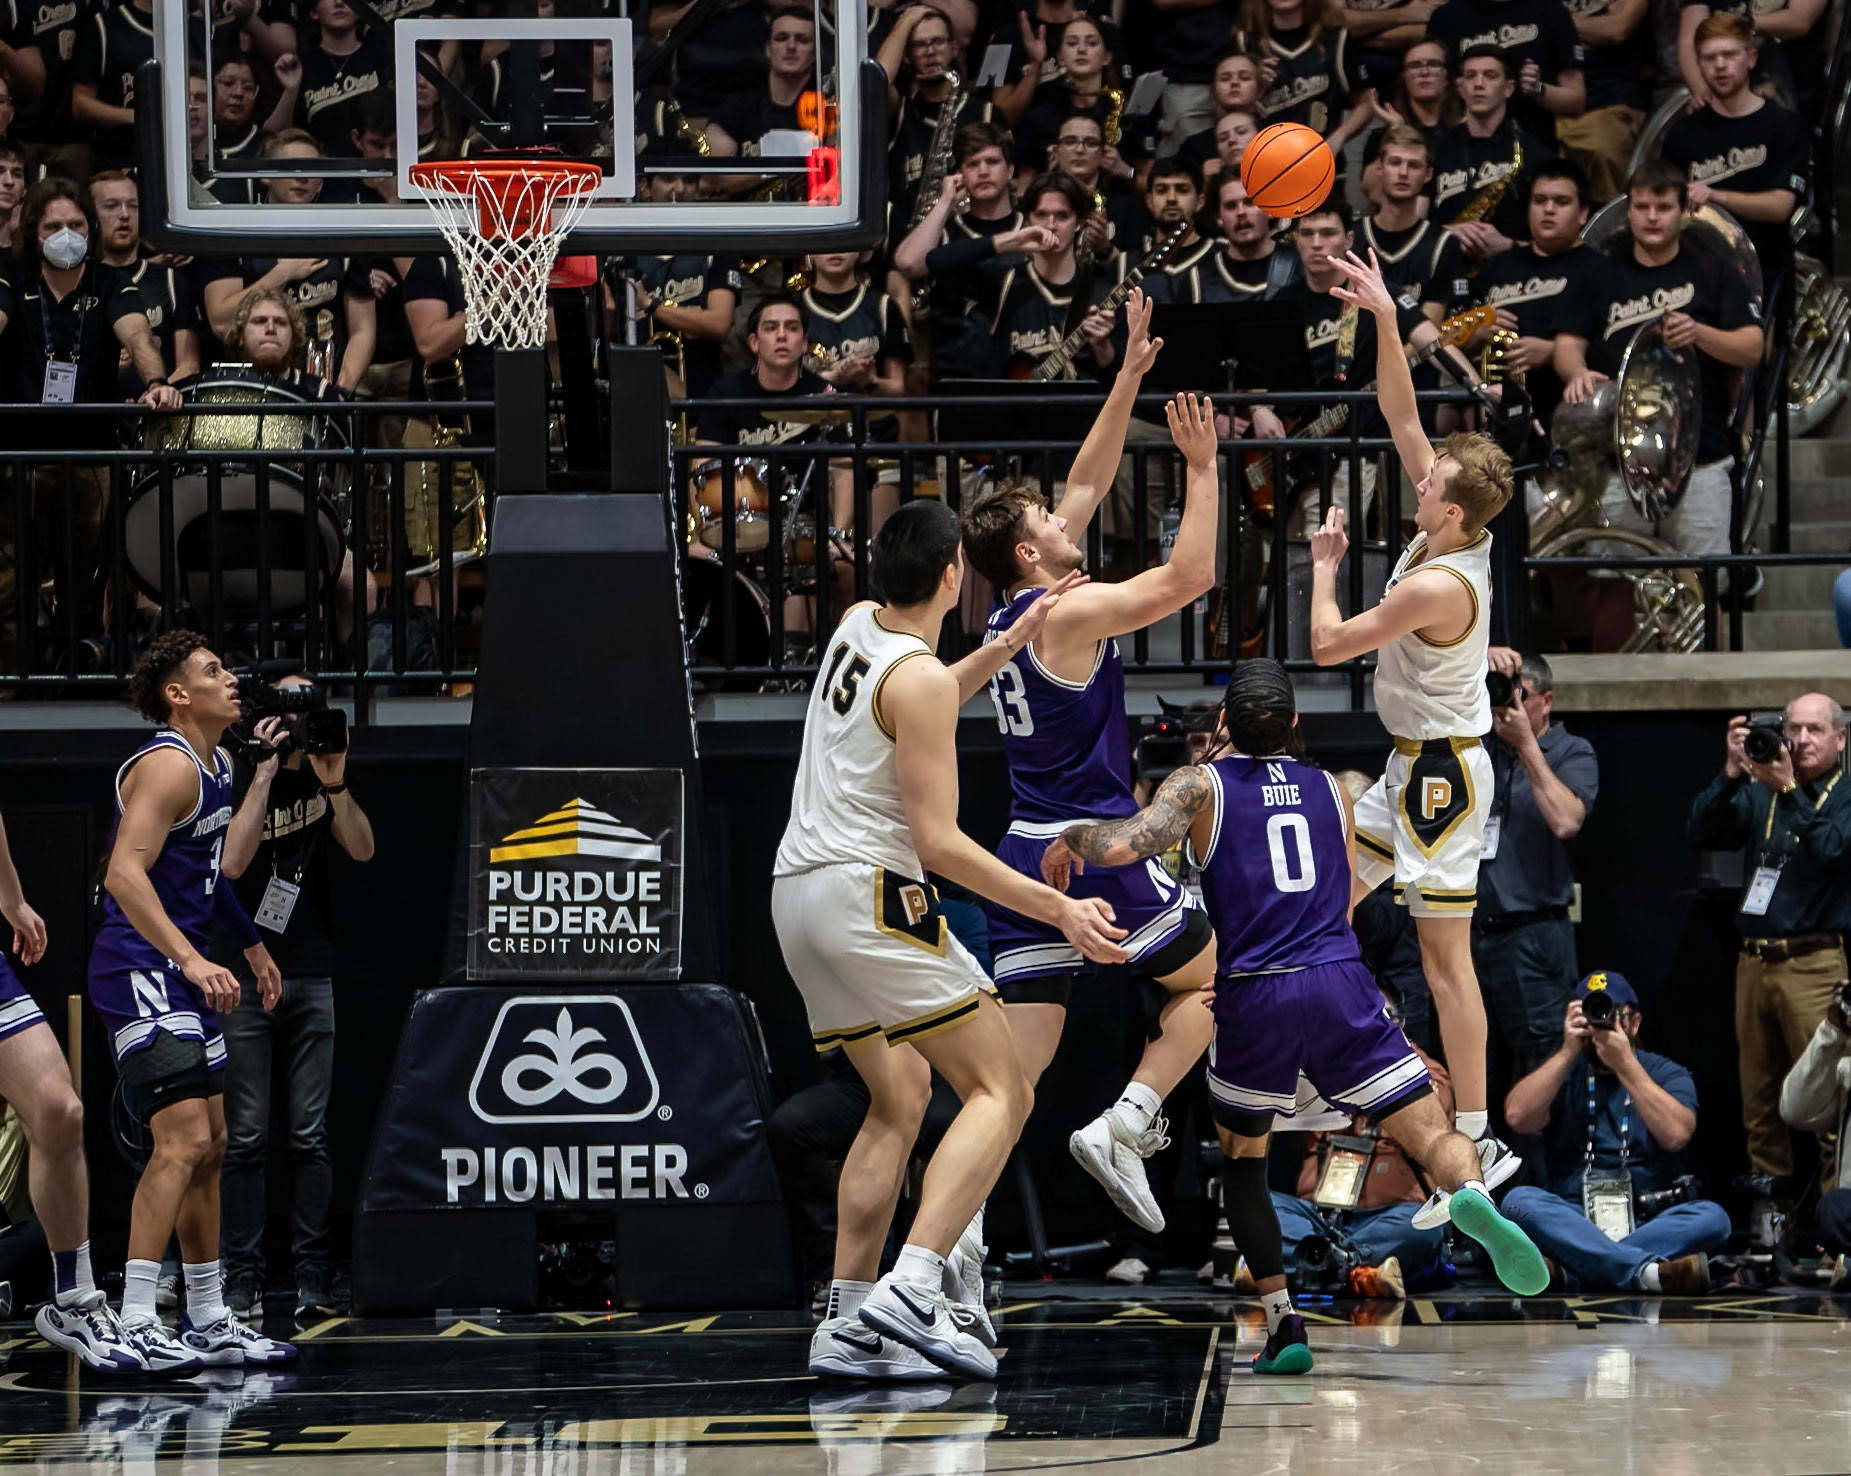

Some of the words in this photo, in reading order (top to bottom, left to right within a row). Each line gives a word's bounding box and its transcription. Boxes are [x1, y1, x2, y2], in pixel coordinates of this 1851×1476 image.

[1608, 294, 1652, 325] Paint
[1651, 281, 1695, 310] Crew
[1010, 328, 1048, 353] Paint
[738, 422, 777, 445] Paint
[821, 641, 872, 717] 15
[1267, 762, 1287, 783] N
[1261, 784, 1302, 807] BUIE
[1421, 776, 1452, 820] P
[1266, 812, 1317, 893] 0
[488, 870, 661, 902] PURDUE
[1145, 857, 1177, 903] N
[487, 905, 661, 934] FEDERAL
[898, 883, 928, 926] P
[487, 937, 571, 954] CREDIT
[582, 937, 661, 954] UNION
[130, 969, 171, 1018] N
[441, 1143, 690, 1203] PIONEER
